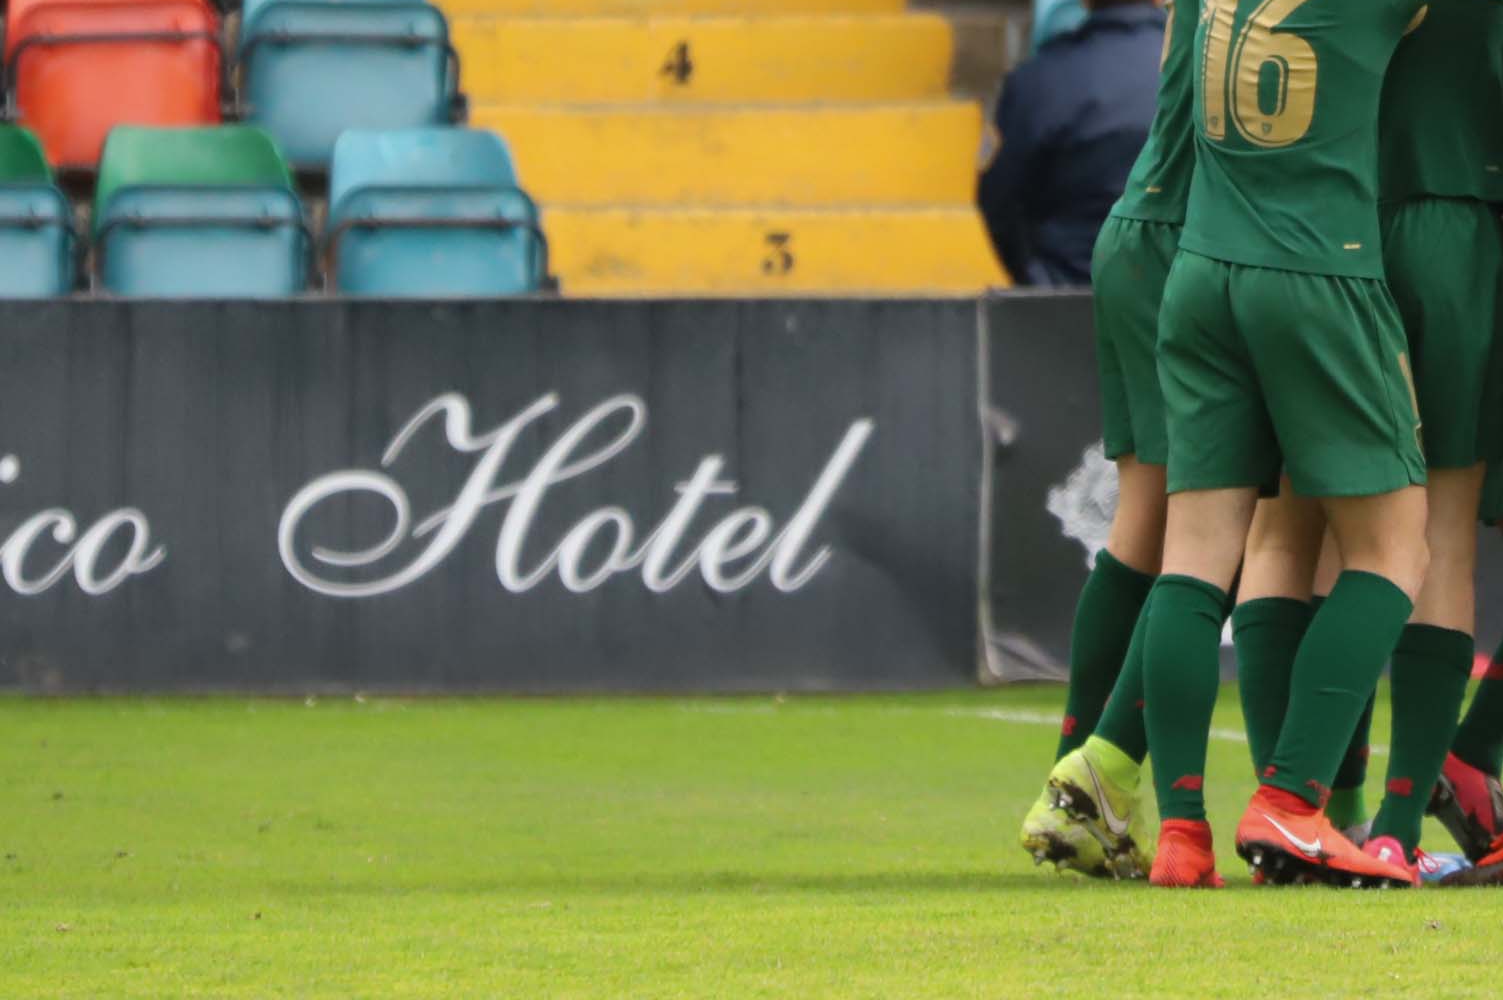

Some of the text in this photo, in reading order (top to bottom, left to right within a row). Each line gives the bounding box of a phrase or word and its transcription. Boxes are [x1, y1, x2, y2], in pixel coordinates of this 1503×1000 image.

[659, 42, 695, 85] 4
[761, 232, 796, 275] 3
[0, 393, 874, 598] co Hotel
